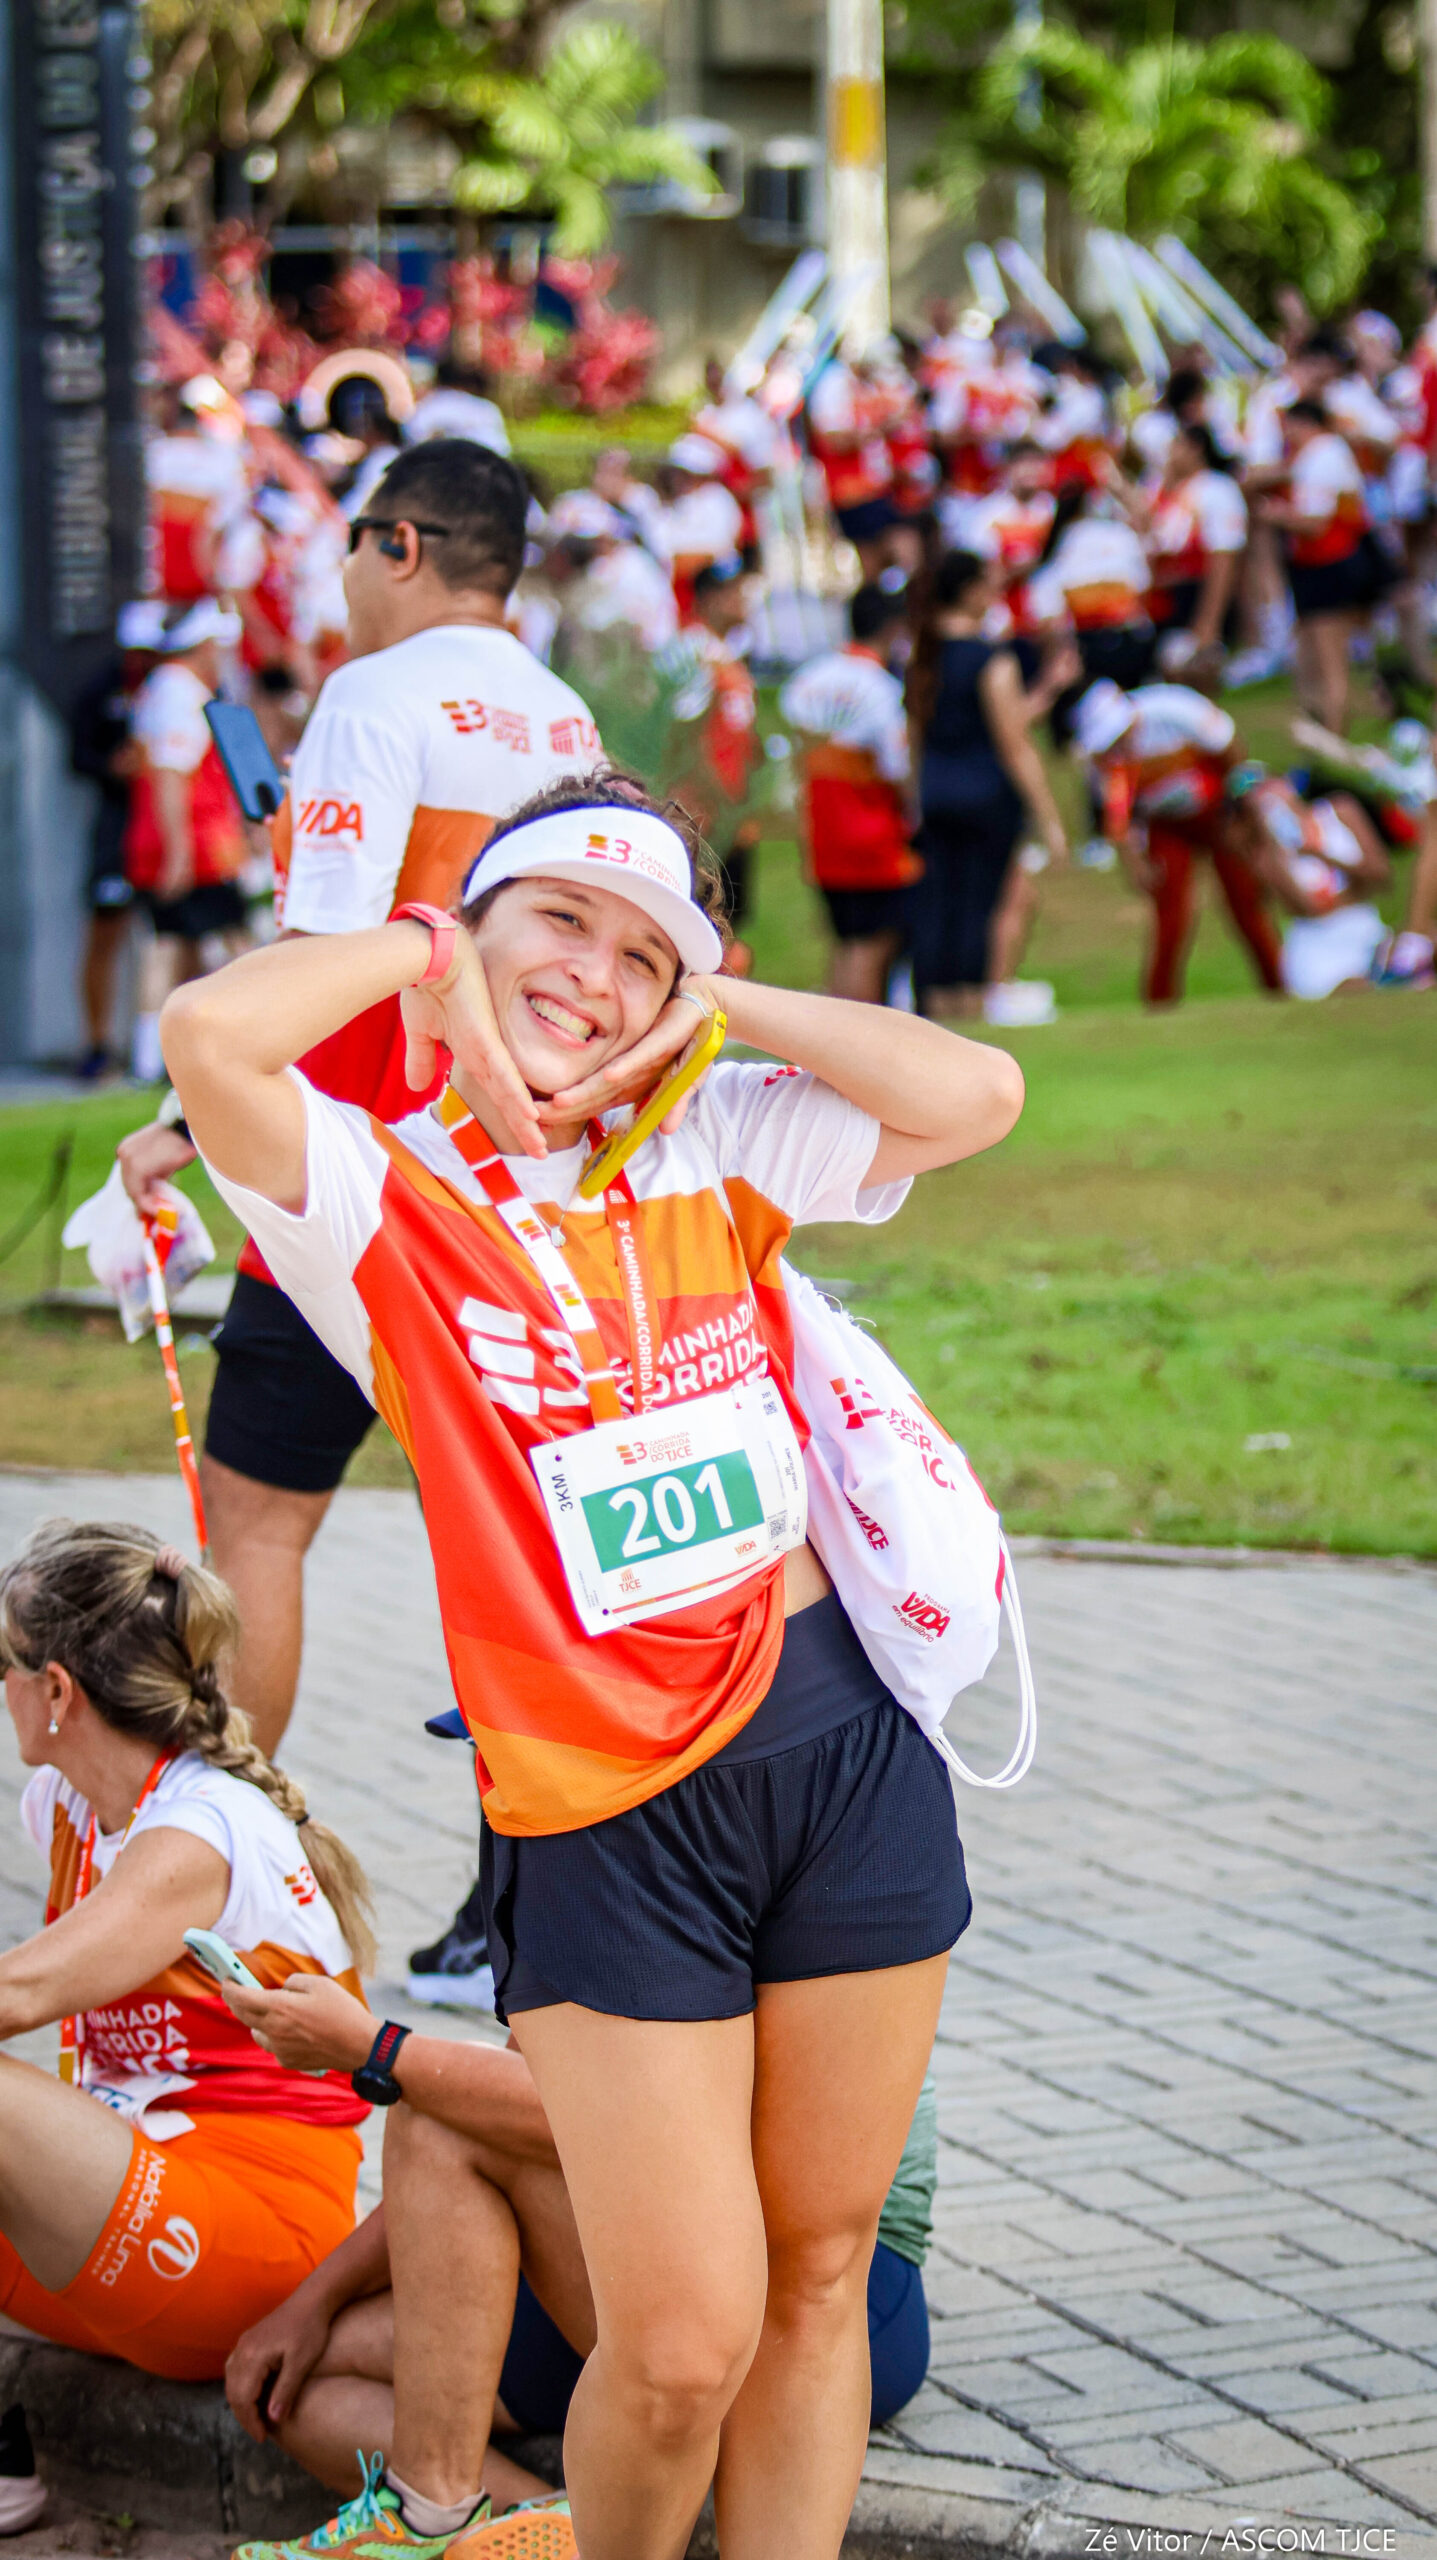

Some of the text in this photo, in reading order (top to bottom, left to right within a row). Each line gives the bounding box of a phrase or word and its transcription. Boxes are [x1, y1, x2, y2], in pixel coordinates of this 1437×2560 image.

[650, 1445, 693, 1463] DO TJCE
[551, 1473, 574, 1512] 3KM
[608, 1463, 733, 1558] 201
[619, 1578, 641, 1592] TJCE
[891, 1604, 903, 1617] em
[900, 1591, 951, 1638] VIDA
